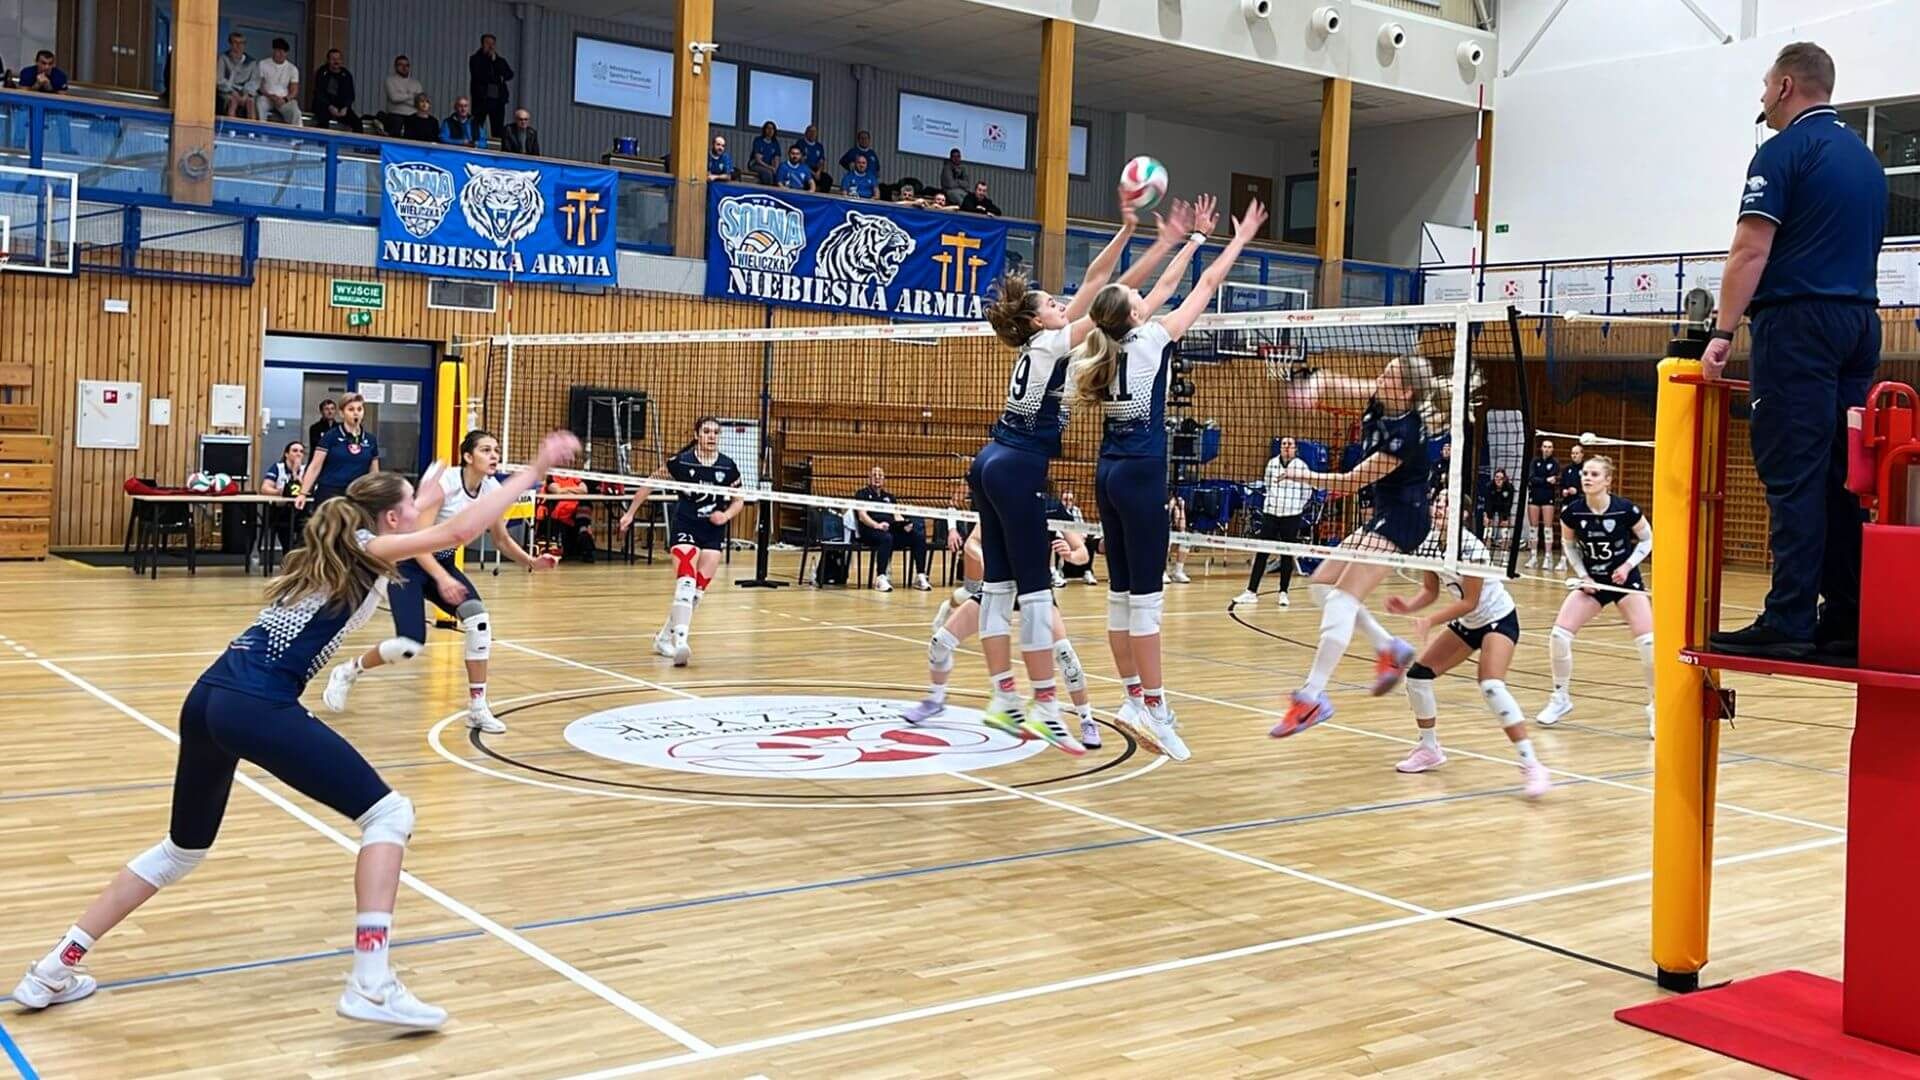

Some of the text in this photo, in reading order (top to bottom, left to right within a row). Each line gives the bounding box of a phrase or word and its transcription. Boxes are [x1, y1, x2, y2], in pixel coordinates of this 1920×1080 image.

[400, 204, 441, 217] WIELICZKA
[382, 240, 612, 276] NIEBIESKA ARMIA
[736, 253, 786, 272] WIELICZKA
[336, 285, 380, 297] WYJŚCIE
[727, 267, 983, 319] NIEBIESKA ARMIA
[1012, 353, 1032, 401] 9
[677, 532, 696, 544] 21
[1586, 541, 1613, 561] 13
